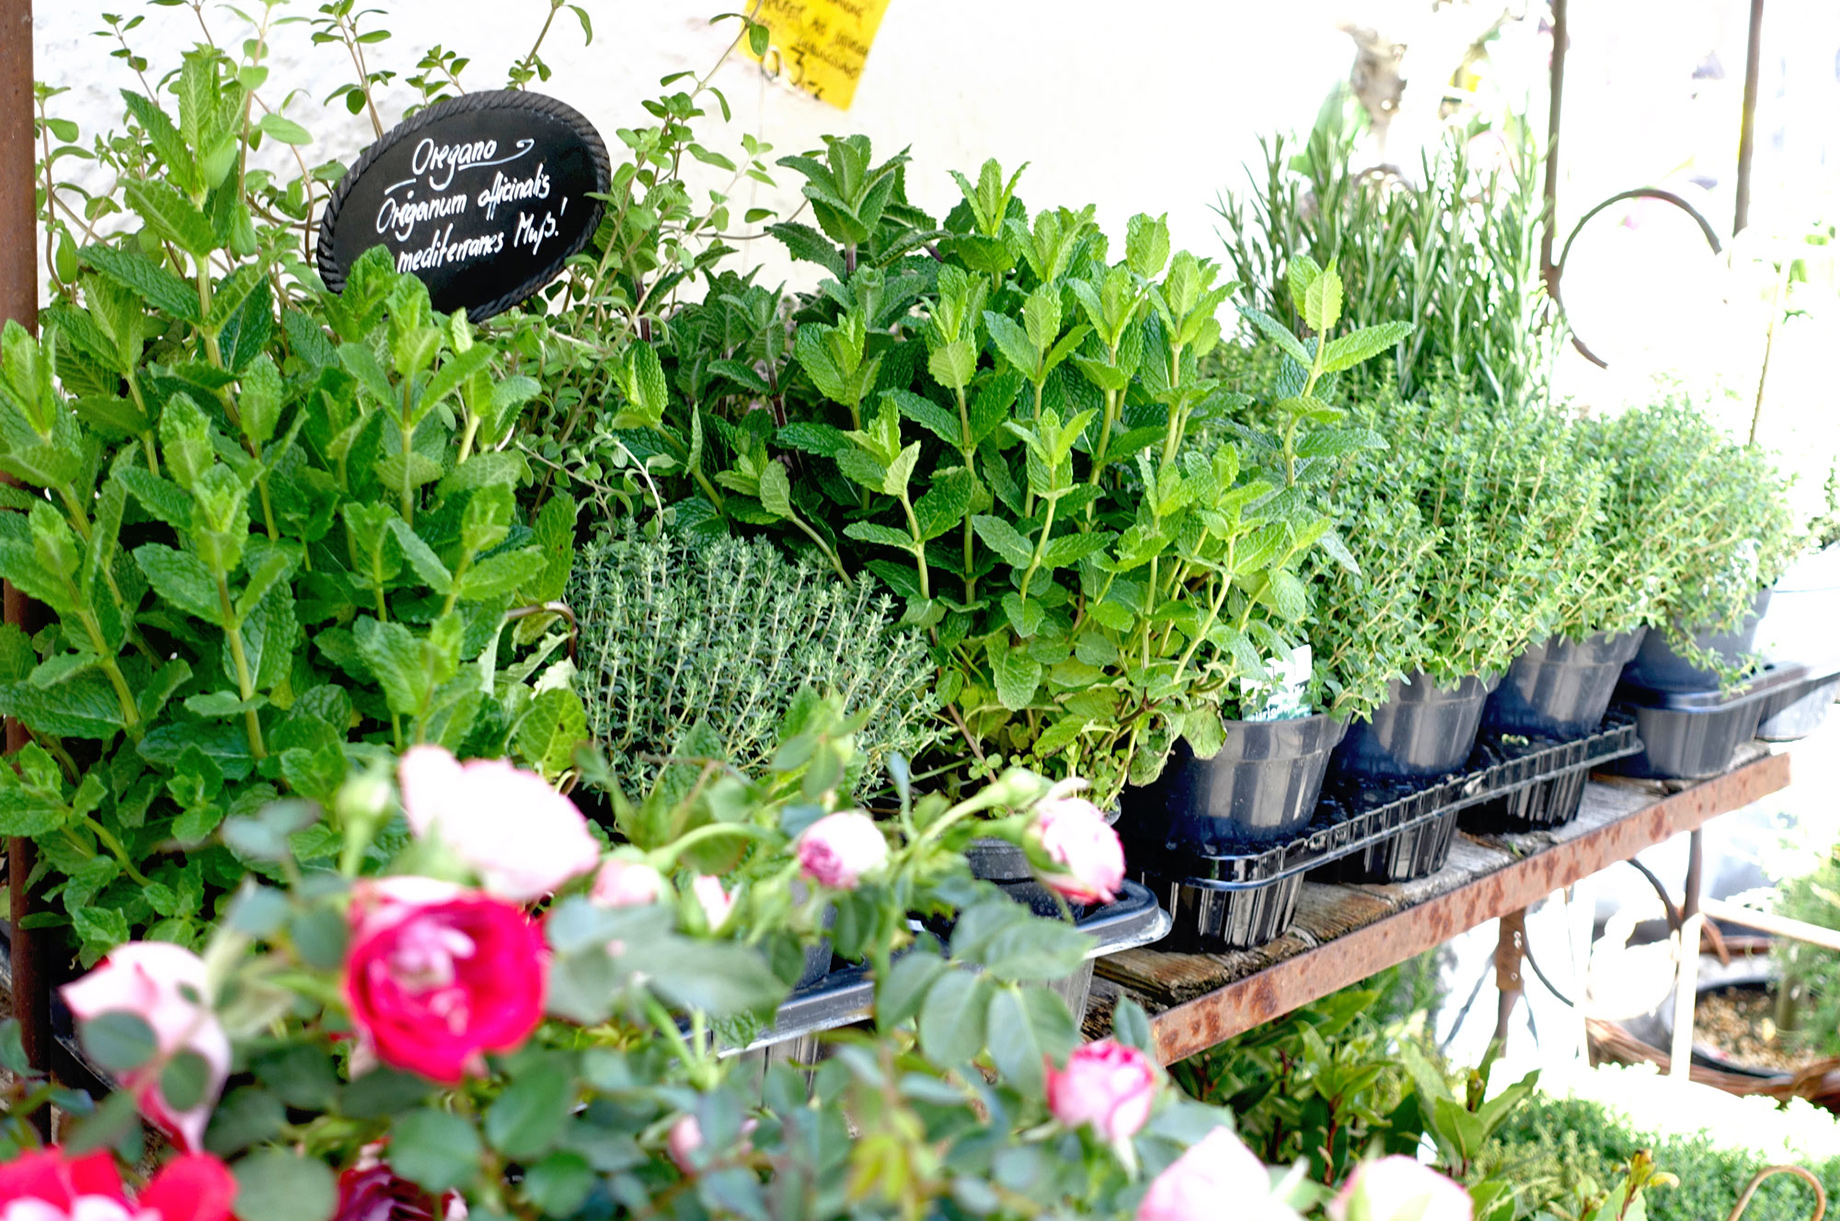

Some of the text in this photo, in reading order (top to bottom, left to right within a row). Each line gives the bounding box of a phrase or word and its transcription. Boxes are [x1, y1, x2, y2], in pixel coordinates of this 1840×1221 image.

[412, 138, 497, 191] Oregano
[376, 163, 551, 242] Origanum officinalis
[396, 223, 505, 274] mediterranes
